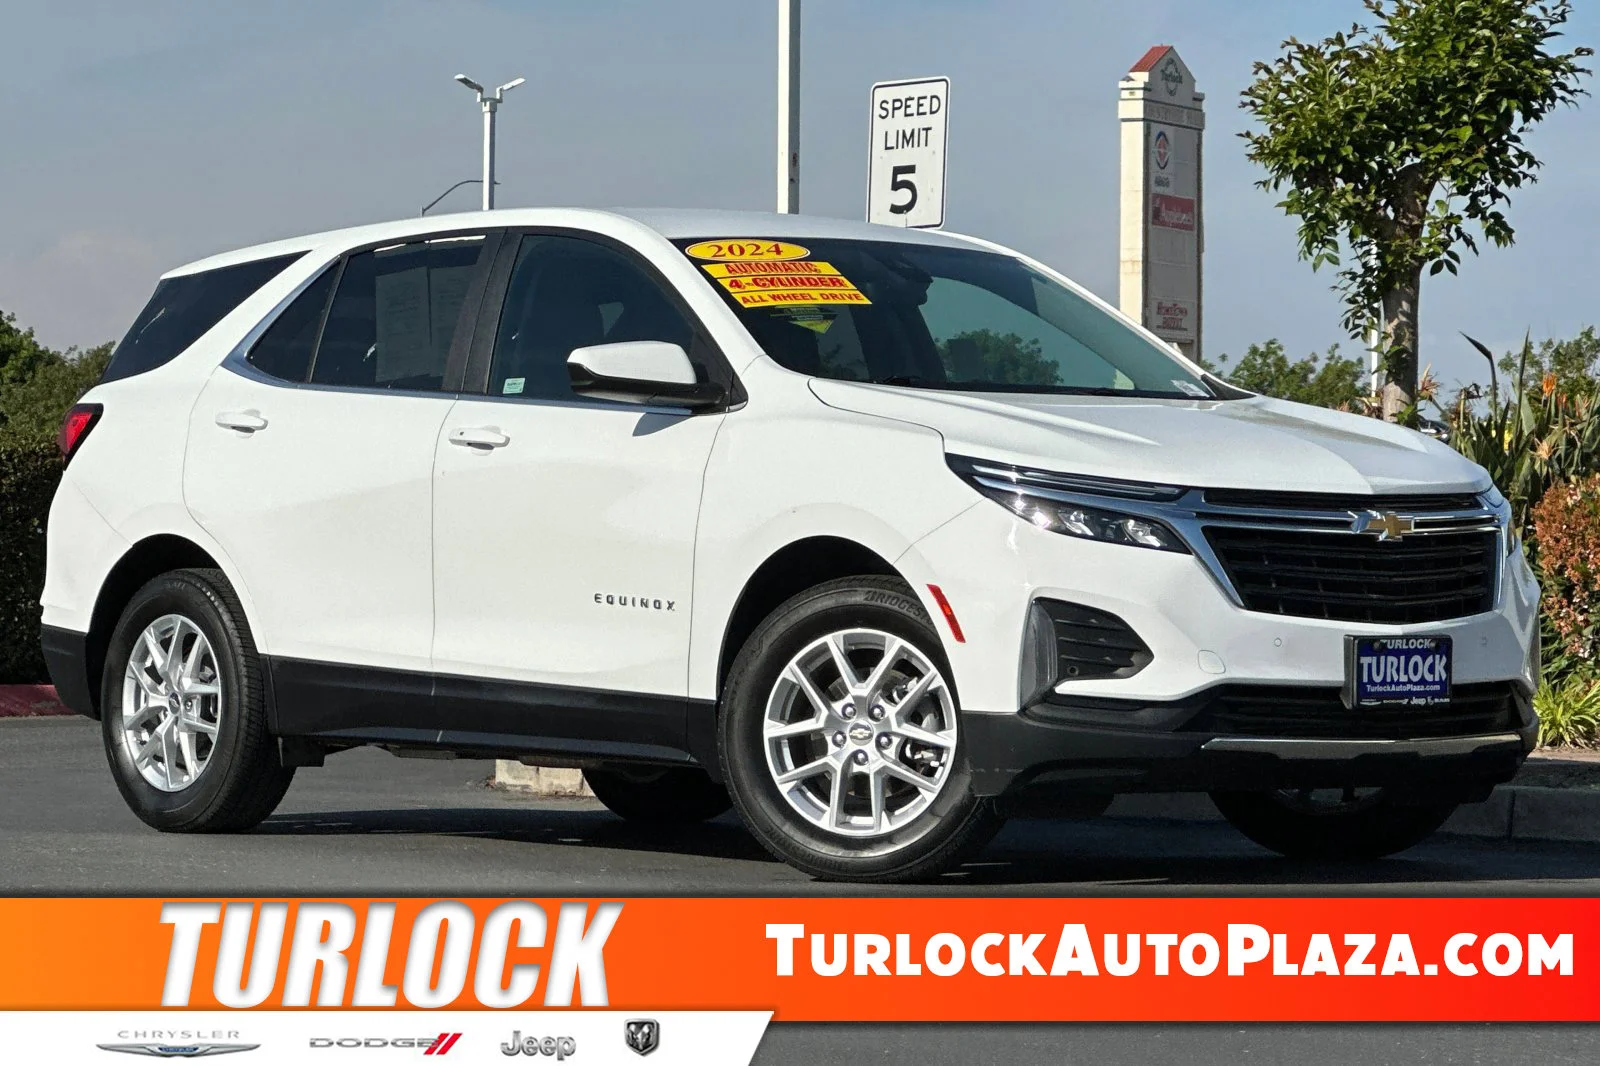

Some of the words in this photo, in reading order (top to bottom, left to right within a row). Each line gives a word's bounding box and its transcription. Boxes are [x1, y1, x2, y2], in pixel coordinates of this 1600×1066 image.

[878, 94, 941, 120] SPEED
[884, 126, 932, 150] LIMIT
[889, 164, 918, 215] 5
[707, 243, 783, 258] 2024
[724, 262, 822, 275] AUTOMATIC
[728, 276, 848, 290] 4-CYLINDER
[741, 294, 769, 304] ALL
[770, 292, 818, 302] WHEEL
[821, 292, 863, 301] DRIVE
[594, 593, 675, 611] EQUINOX
[1360, 654, 1447, 683] TURLOCK
[1366, 684, 1440, 692] TurlockAutoPlaza.com
